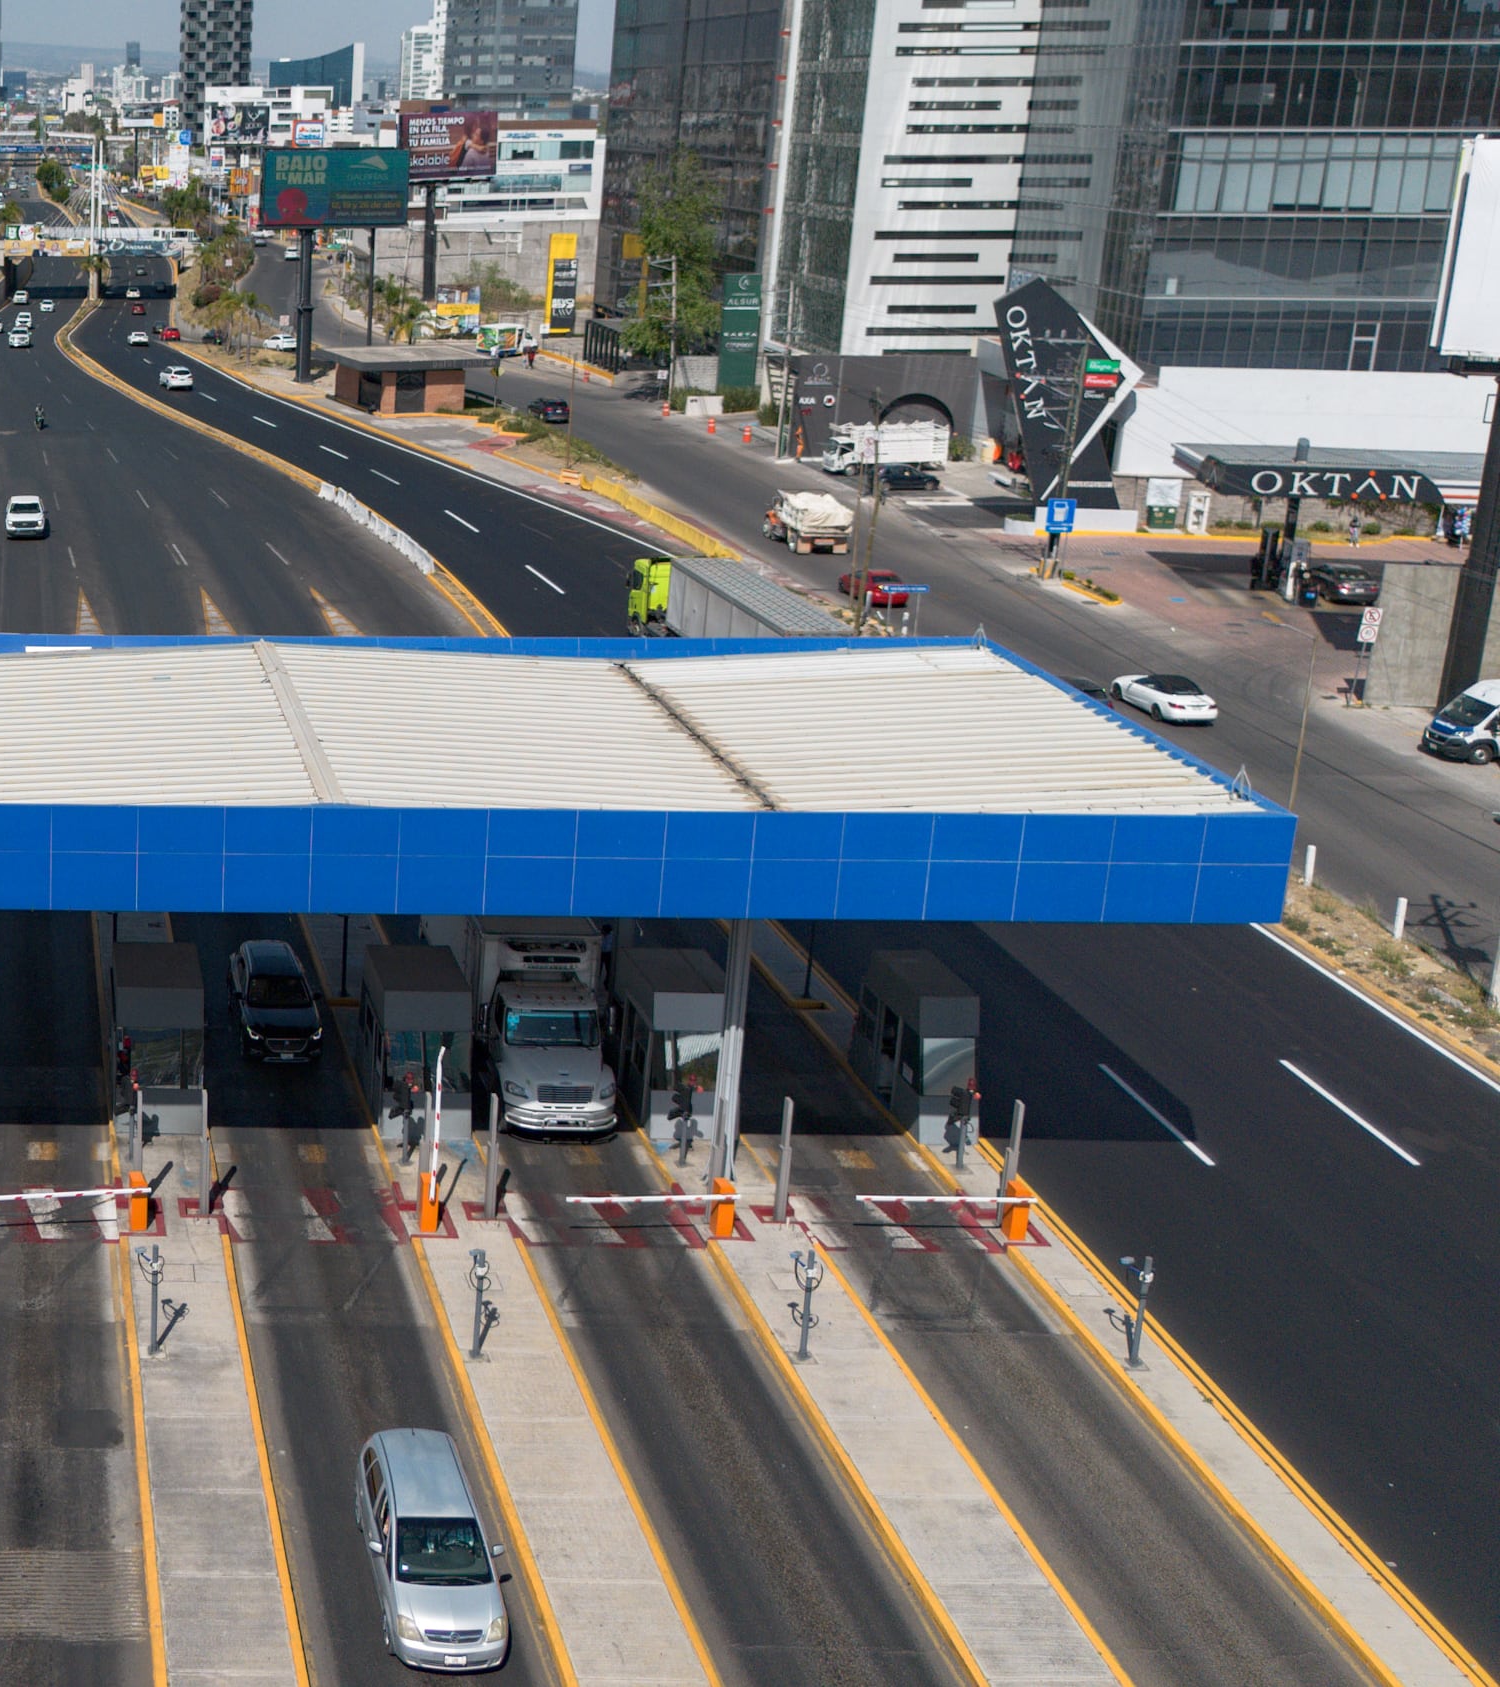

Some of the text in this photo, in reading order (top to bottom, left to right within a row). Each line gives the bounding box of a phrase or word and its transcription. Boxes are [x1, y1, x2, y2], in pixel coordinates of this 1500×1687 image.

[409, 116, 465, 126] MENOS TIEMPO
[409, 126, 419, 134] EN
[409, 138, 450, 147] TU FAMILIA
[276, 155, 328, 171] BAJO
[276, 172, 326, 184] EL MAR
[798, 397, 816, 405] AXA
